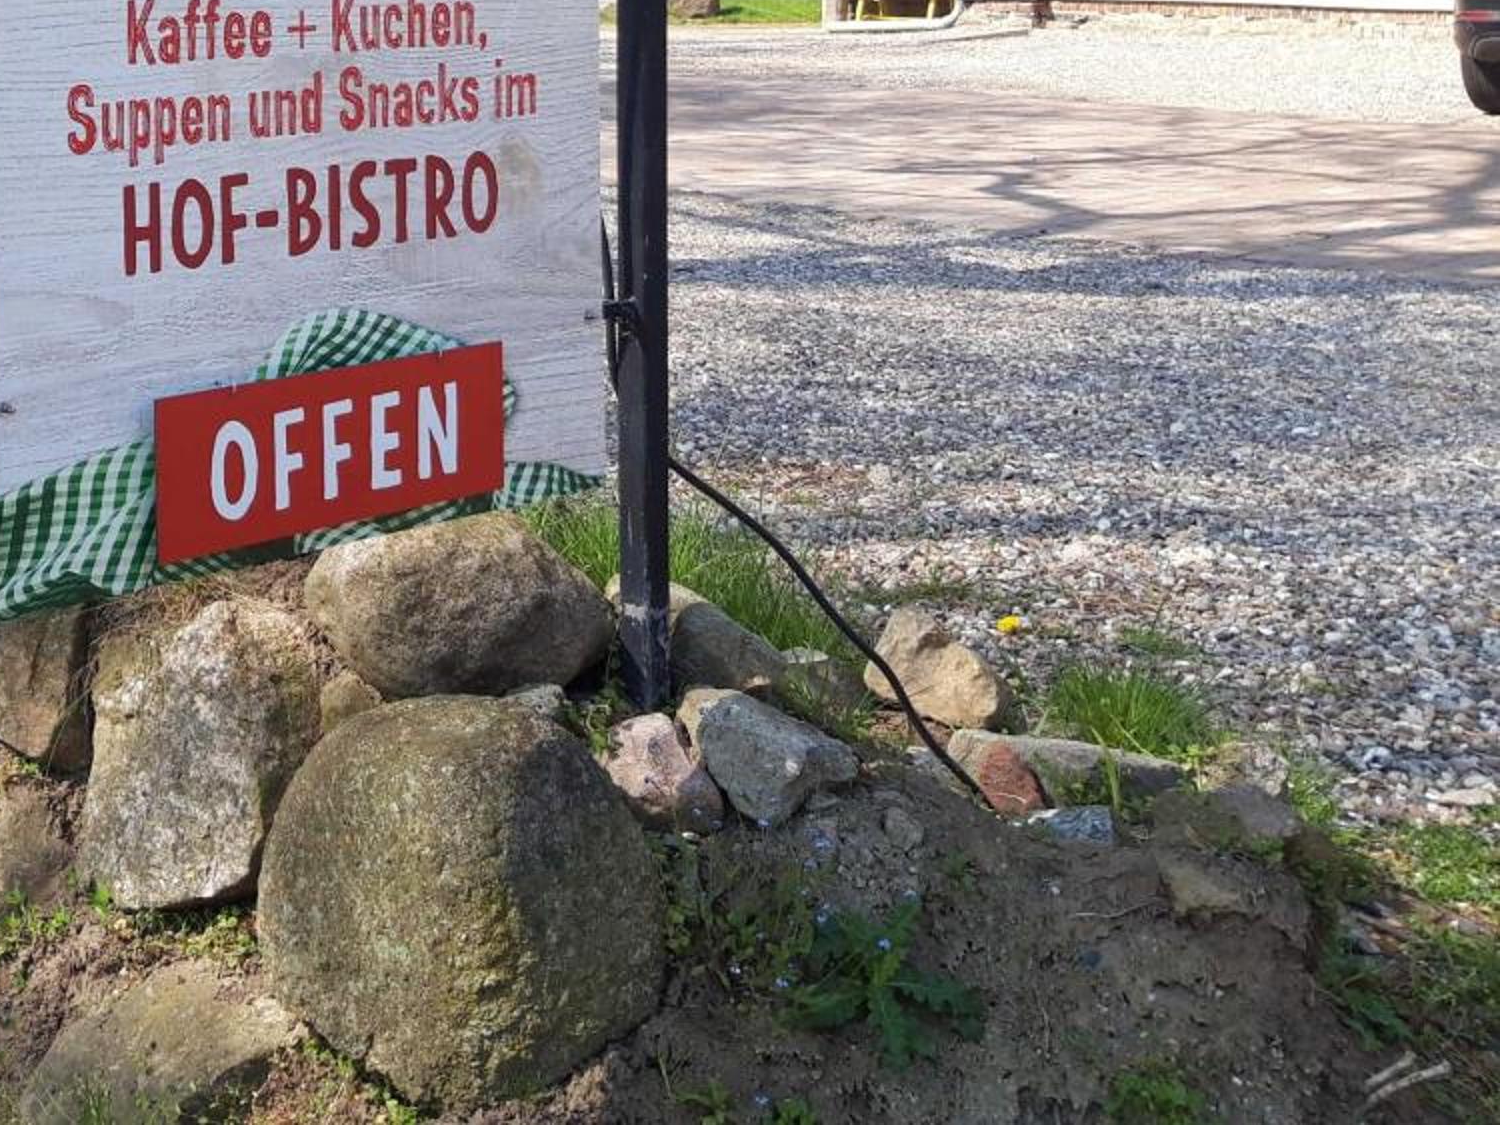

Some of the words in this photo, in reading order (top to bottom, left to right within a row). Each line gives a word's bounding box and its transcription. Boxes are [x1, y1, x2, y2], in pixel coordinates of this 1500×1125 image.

[287, 10, 316, 49] +
[67, 83, 230, 167] Suppen
[249, 71, 323, 138] und
[339, 63, 480, 132] Snacks
[494, 59, 537, 119] im
[122, 150, 499, 276] HOF-BISTRO
[210, 381, 459, 521] OFFEN
